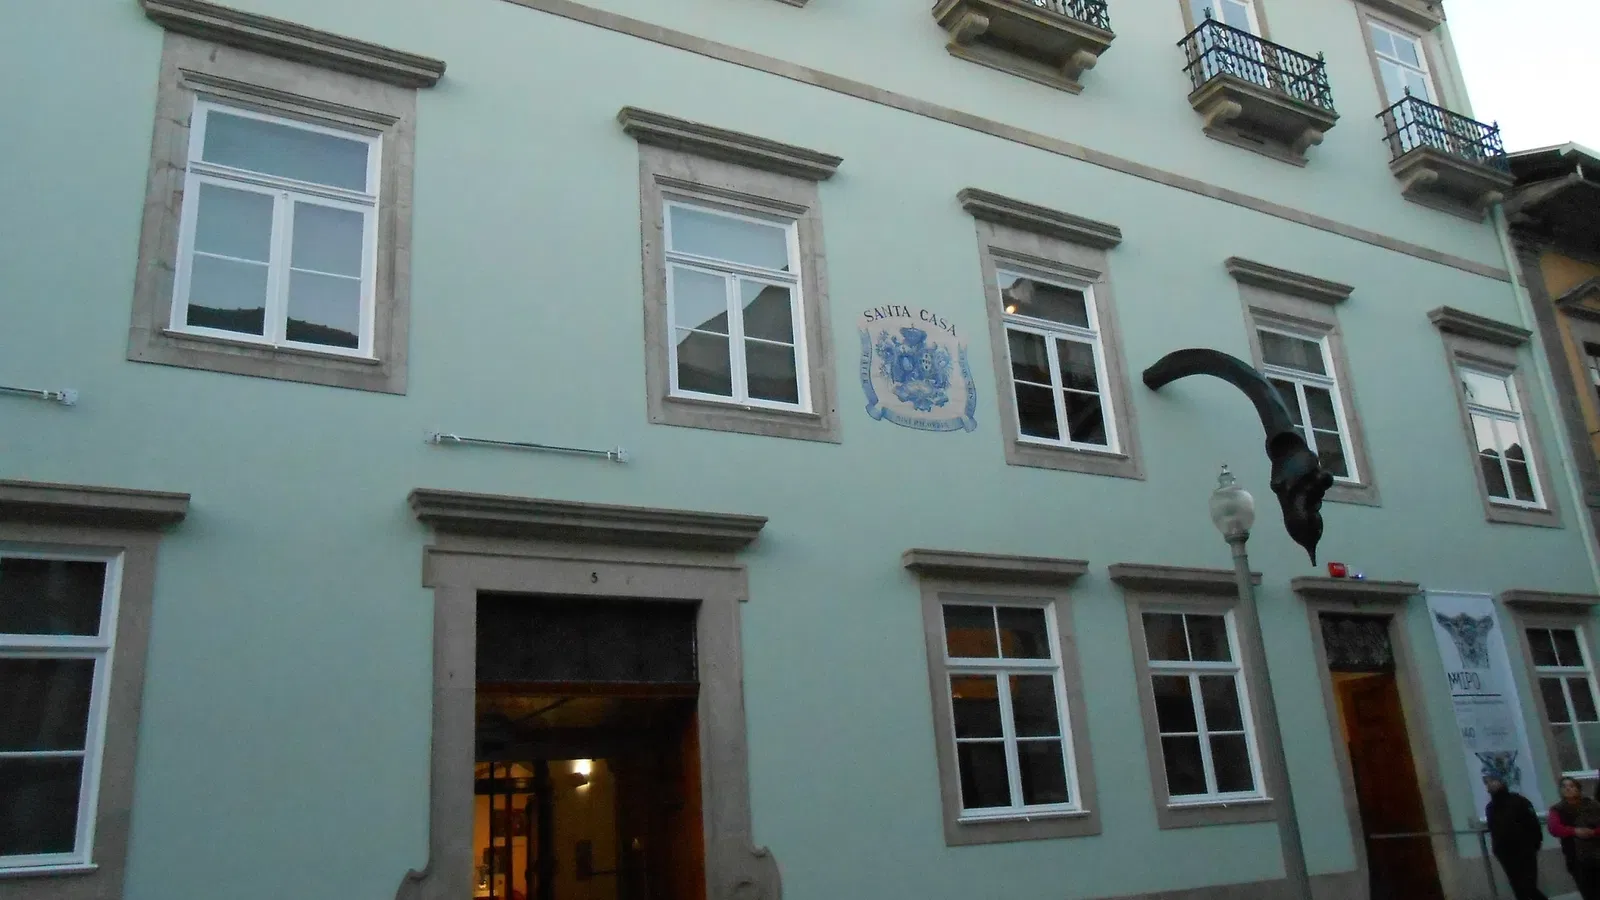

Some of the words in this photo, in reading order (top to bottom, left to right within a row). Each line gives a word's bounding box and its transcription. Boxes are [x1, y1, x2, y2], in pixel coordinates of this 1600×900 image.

[863, 304, 912, 323] SANTA
[919, 308, 957, 337] CASA
[591, 571, 598, 584] 5
